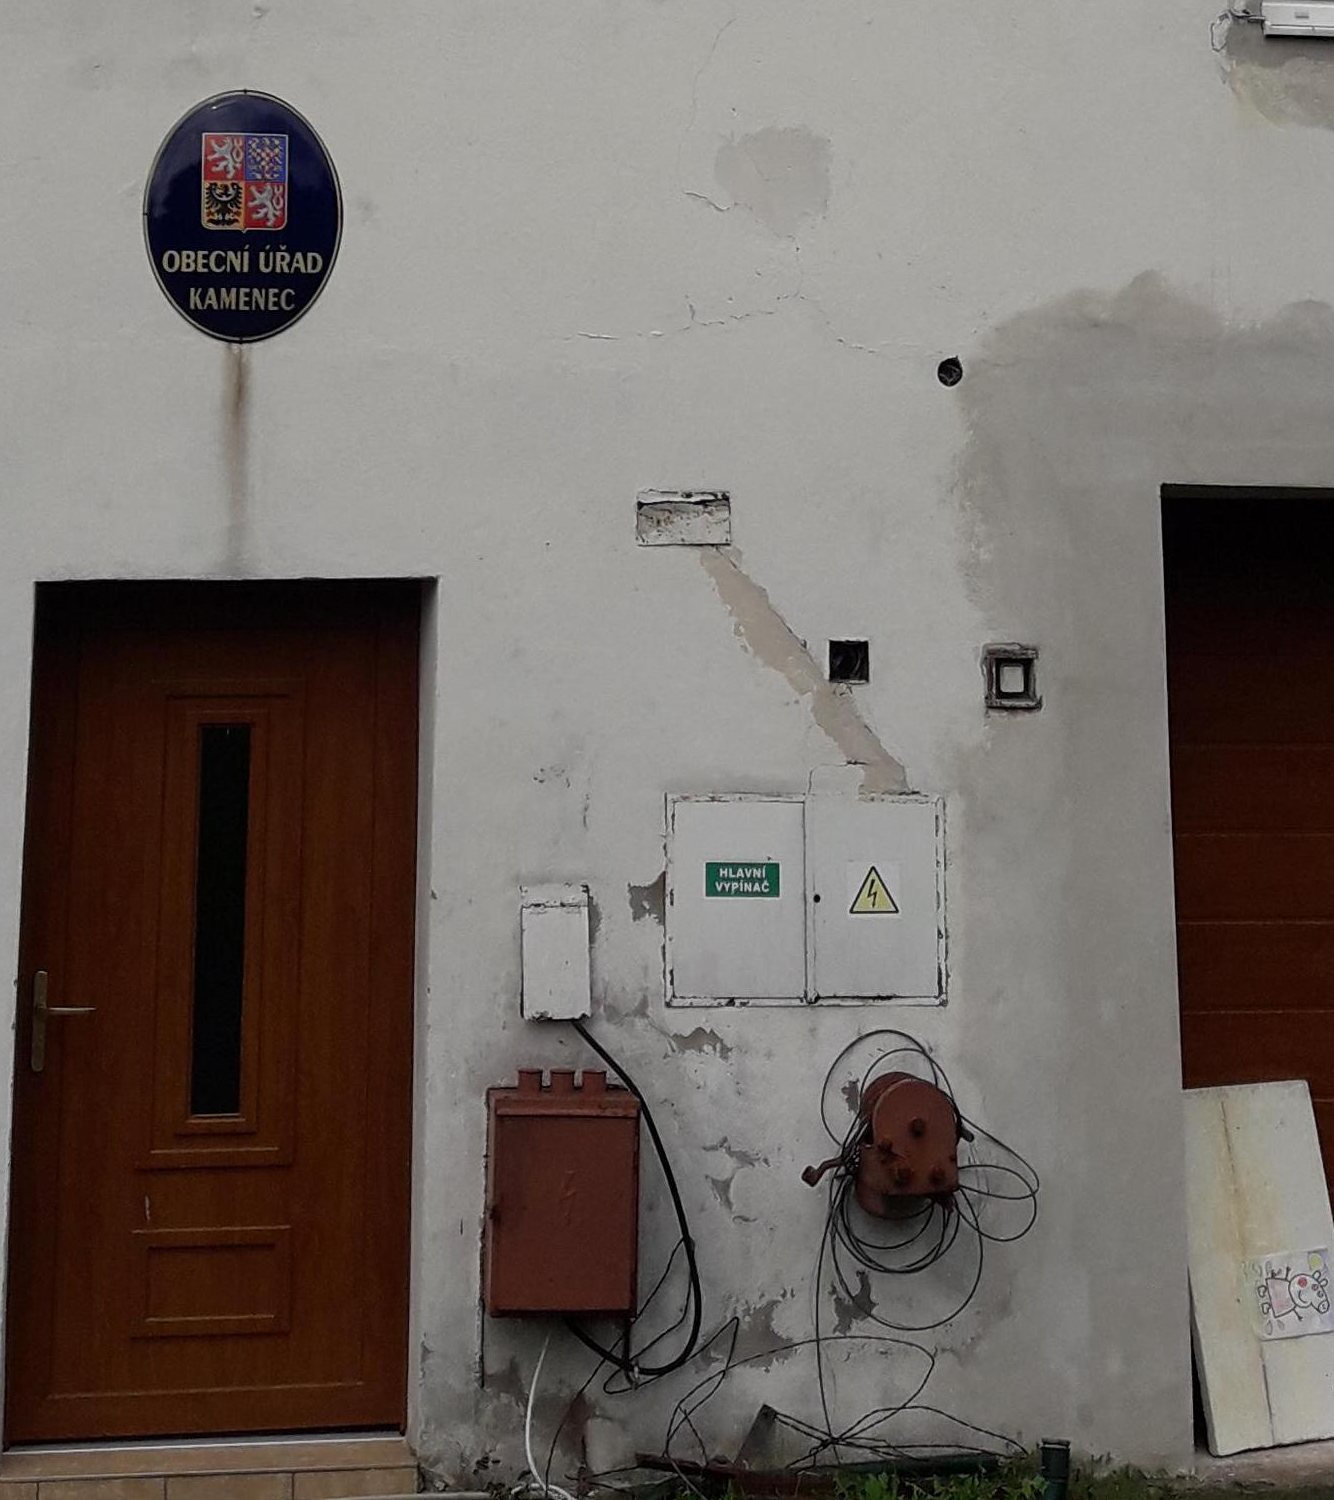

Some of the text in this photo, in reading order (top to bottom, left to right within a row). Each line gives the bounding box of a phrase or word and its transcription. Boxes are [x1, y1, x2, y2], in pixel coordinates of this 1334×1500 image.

[162, 245, 323, 274] OBECNÍ ÚŘAD
[189, 287, 296, 311] KAMENEC
[719, 865, 766, 878] HLAVNÍ
[715, 880, 770, 893] VYPÍNAČ
